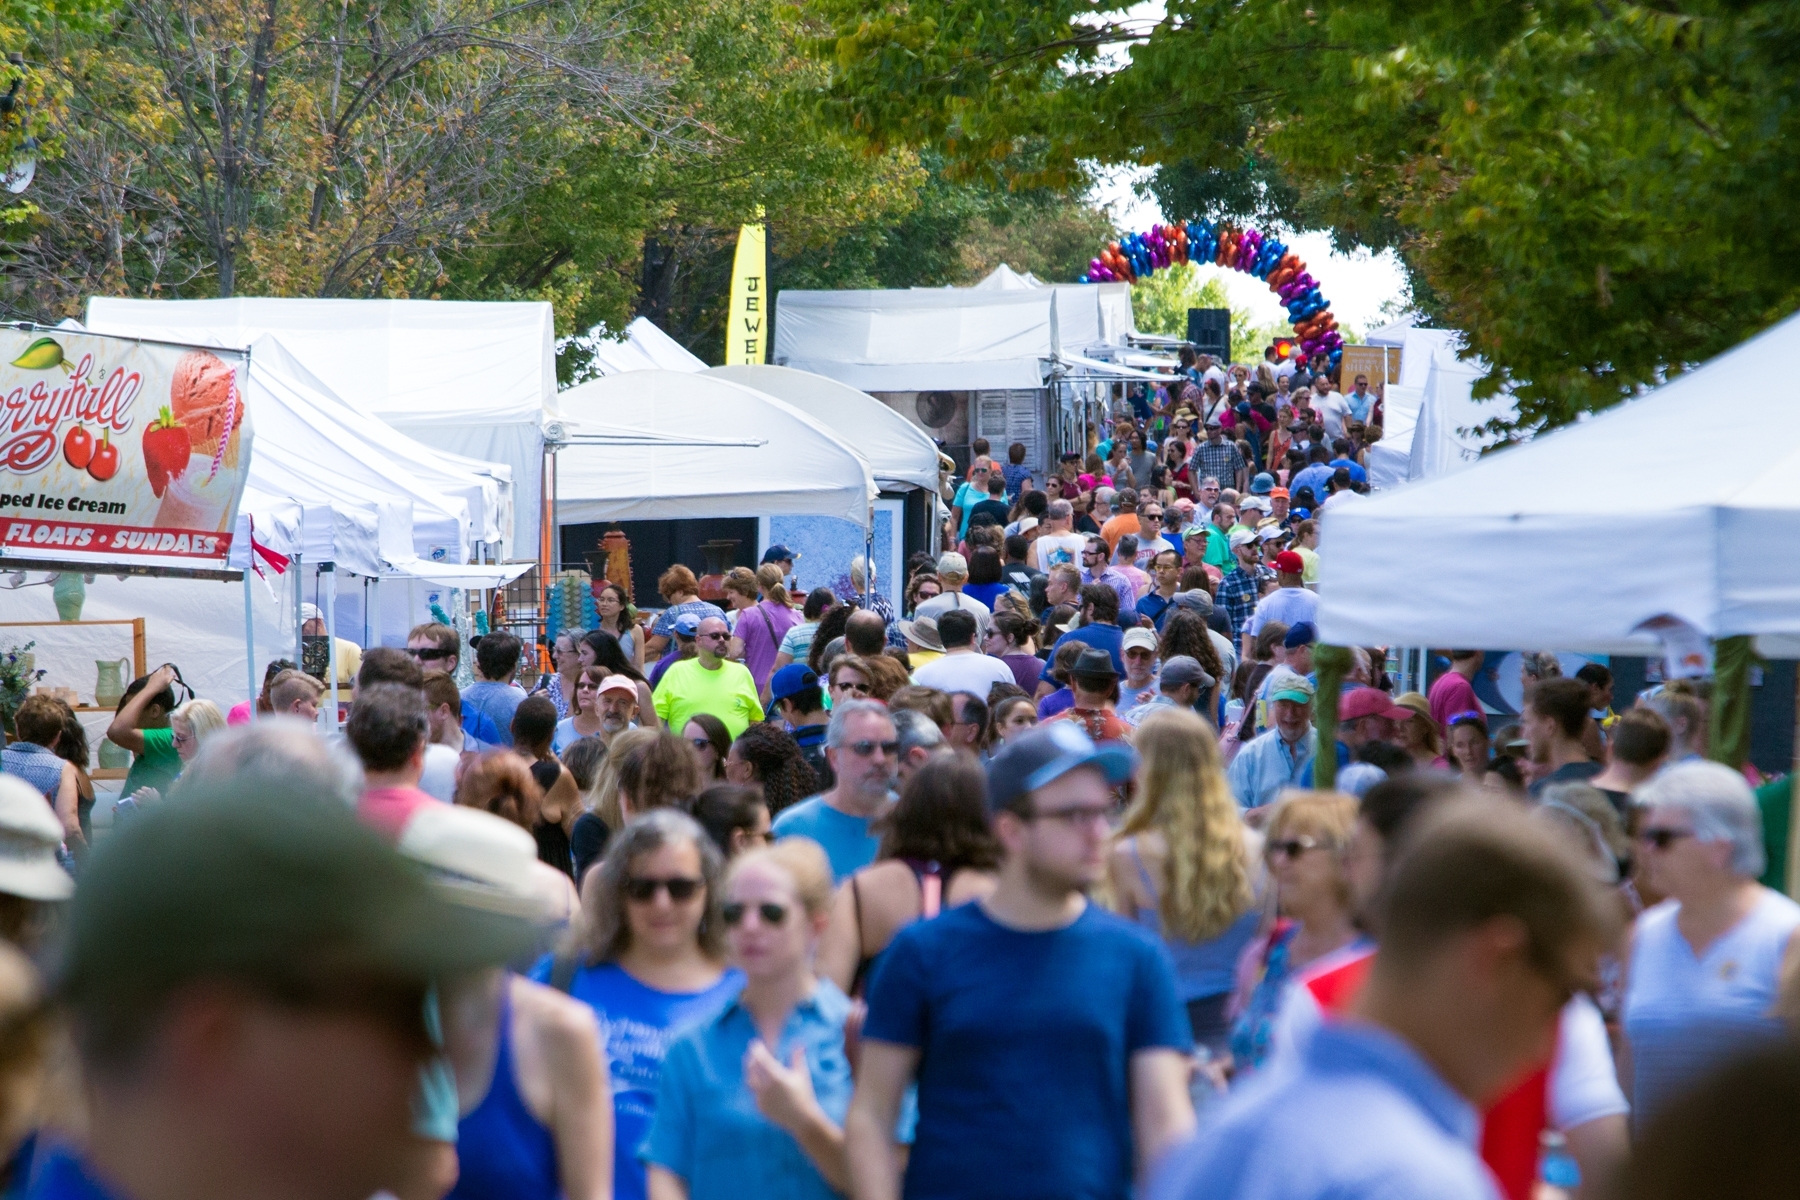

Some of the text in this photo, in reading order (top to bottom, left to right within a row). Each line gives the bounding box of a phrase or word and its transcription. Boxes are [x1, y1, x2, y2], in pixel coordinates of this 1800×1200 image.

[1345, 364, 1371, 372] SHEN
[37, 494, 65, 510] Ice
[67, 496, 127, 515] Cream
[5, 523, 219, 554] FLOATS SUNDAES
